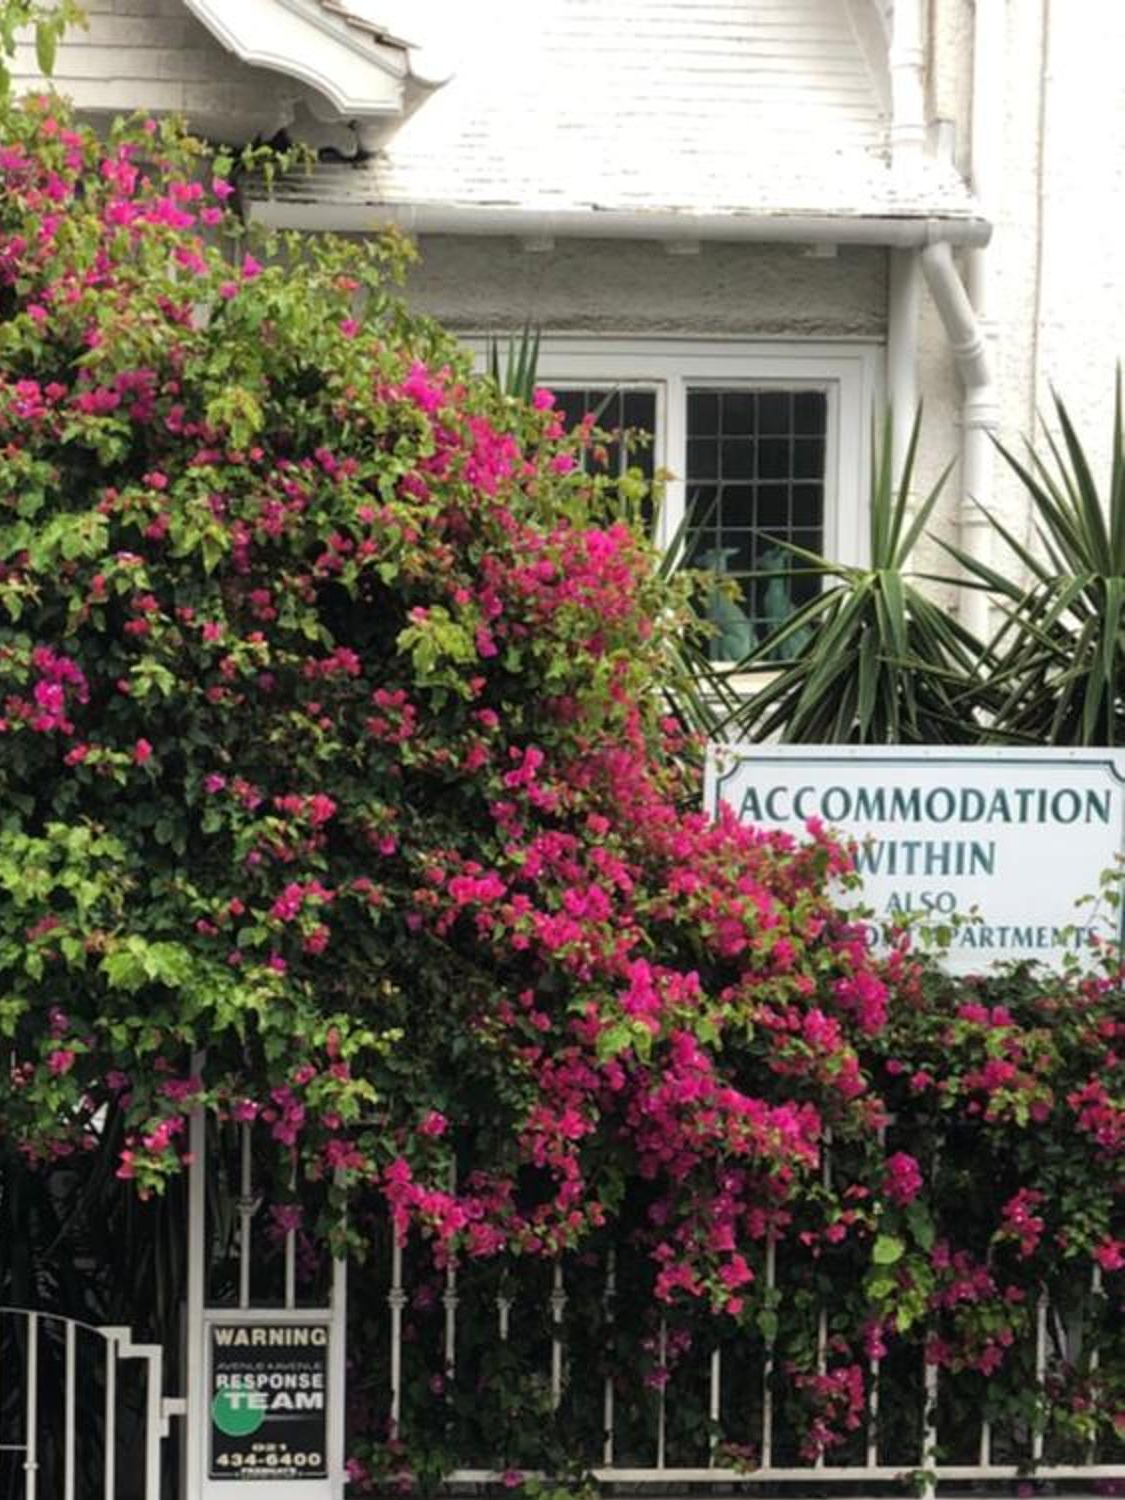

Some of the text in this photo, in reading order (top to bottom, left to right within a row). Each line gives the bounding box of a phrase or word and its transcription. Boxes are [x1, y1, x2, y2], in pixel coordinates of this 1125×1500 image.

[739, 786, 1112, 824] ACCOMMODATION
[852, 839, 995, 876] WITHIN
[885, 890, 956, 915] ALSO
[931, 925, 1099, 949] PARTMENTS
[216, 1328, 327, 1346] WARNING
[216, 1373, 324, 1389] RESPONSE
[225, 1392, 324, 1410] TEAM
[216, 1452, 322, 1467] 434-6400
